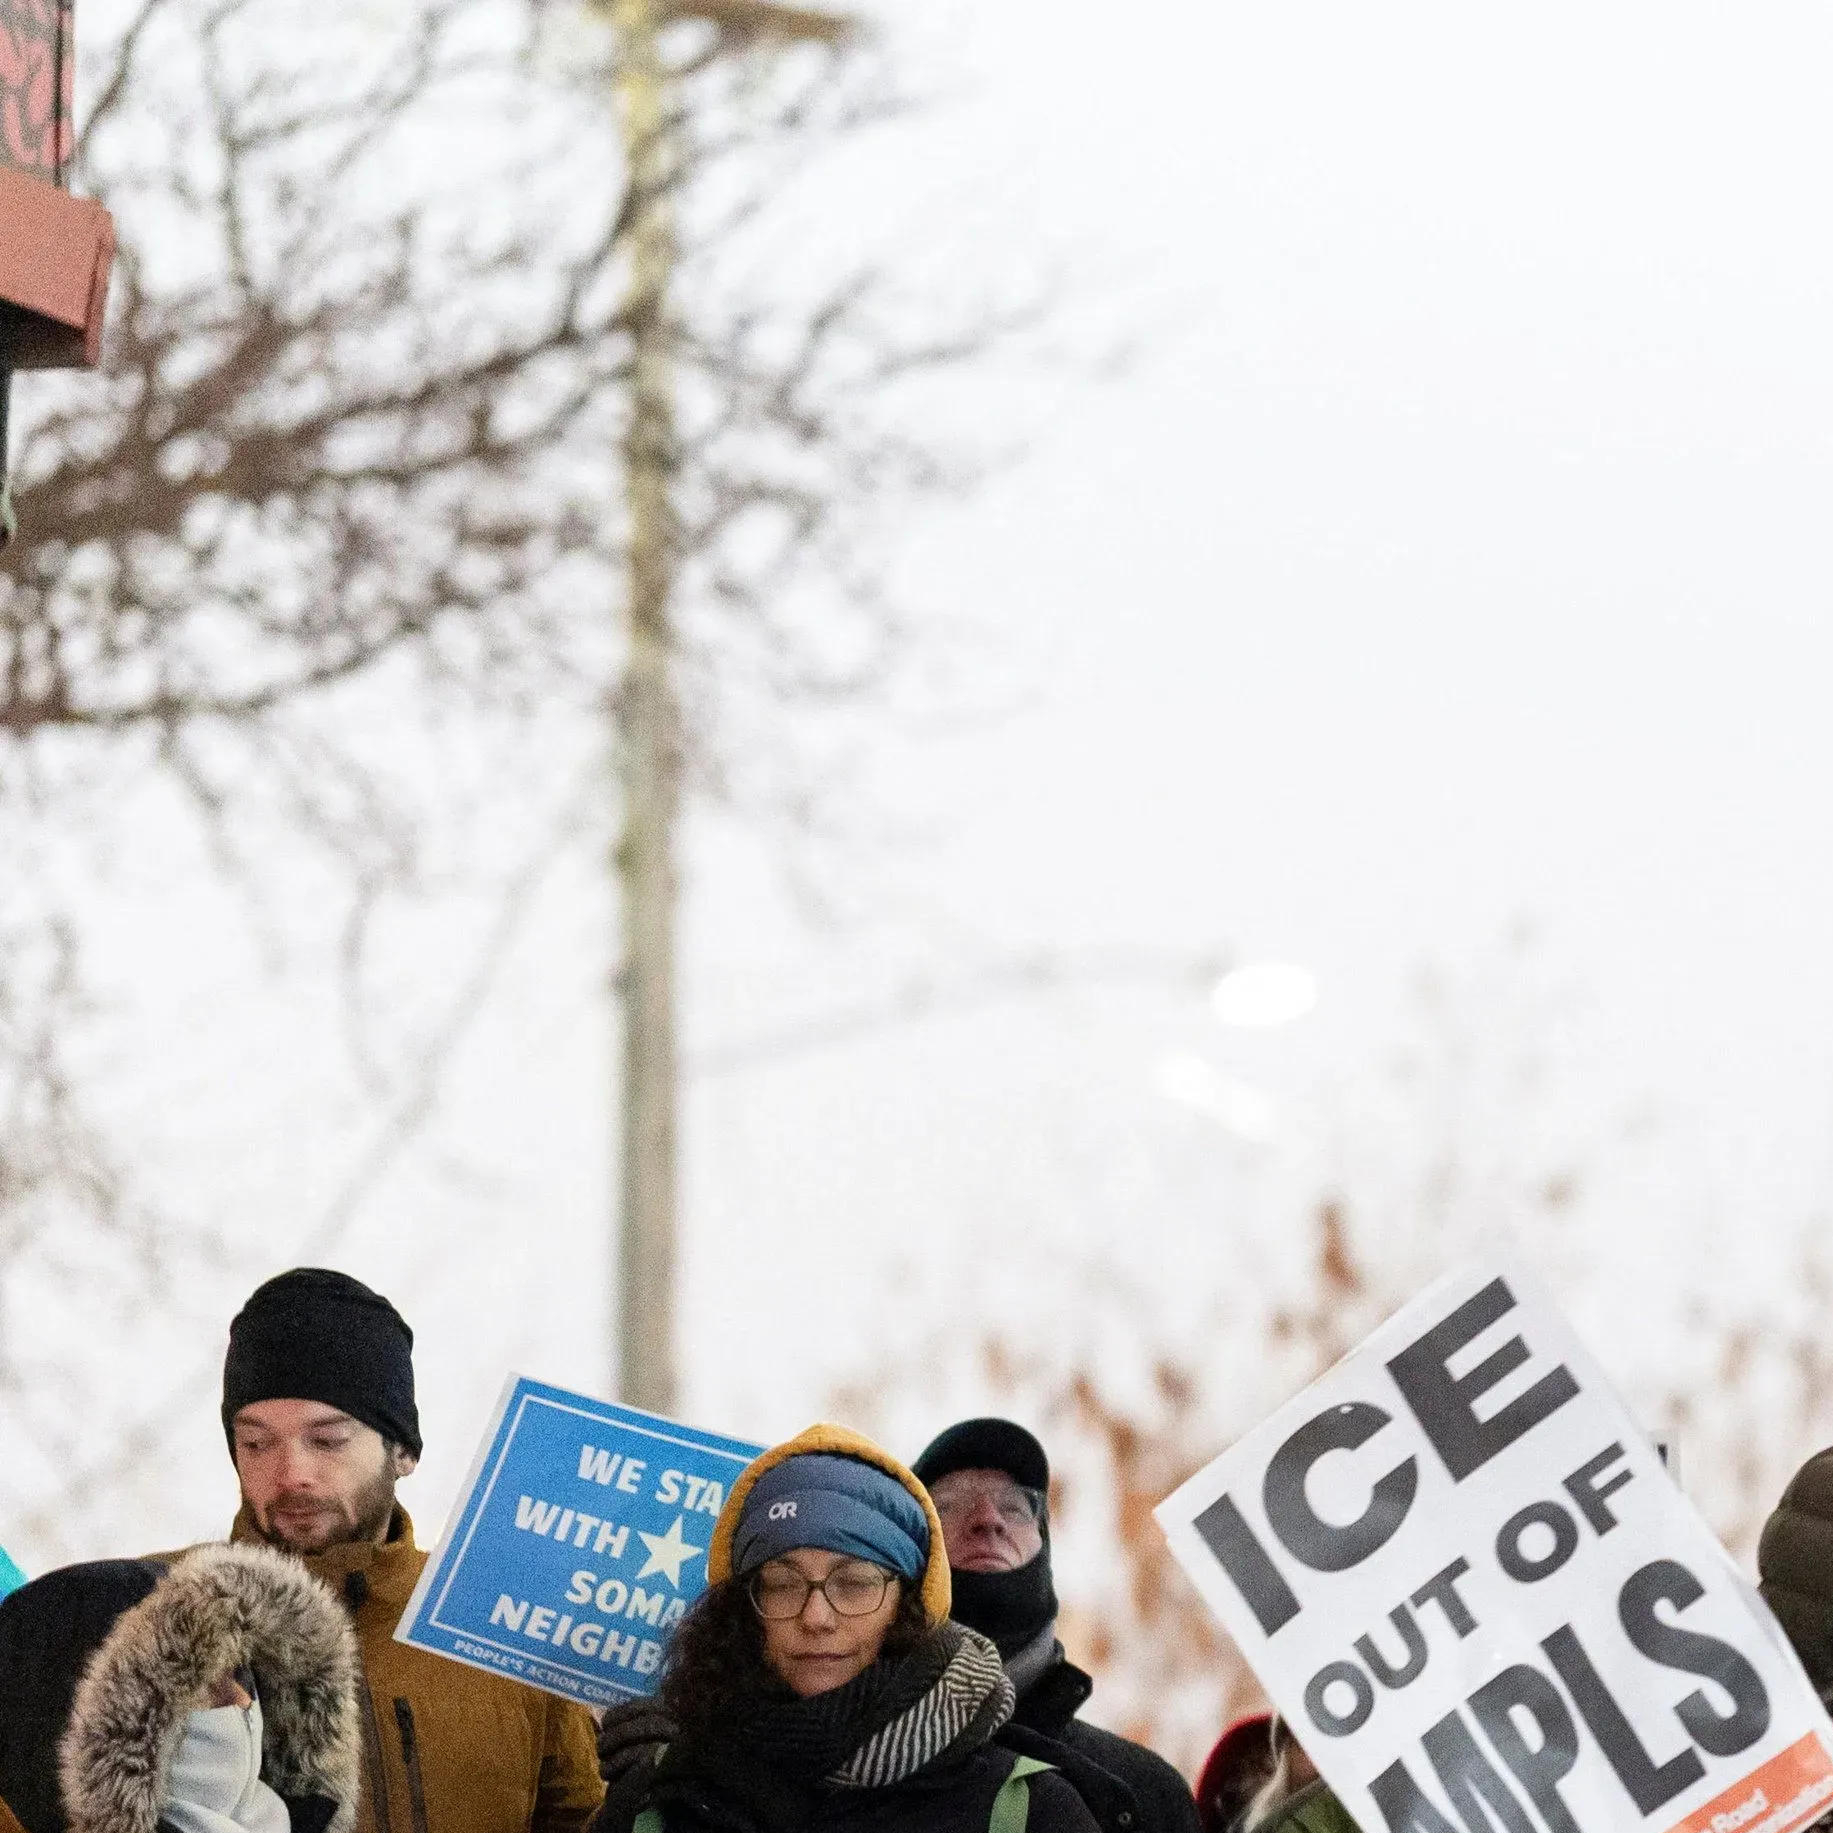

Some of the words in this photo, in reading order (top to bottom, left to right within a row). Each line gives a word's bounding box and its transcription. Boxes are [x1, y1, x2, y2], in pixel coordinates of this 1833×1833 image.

[578, 1443, 647, 1495] WE
[654, 1469, 725, 1517] STA
[1193, 1276, 1581, 1638] ICE
[514, 1494, 631, 1560] WITH
[769, 1501, 797, 1520] OR
[565, 1570, 687, 1628] SOMA
[1304, 1557, 1479, 1739] OUT
[1495, 1440, 1636, 1584] OF
[454, 1639, 526, 1672] PEOPLE'S
[489, 1594, 670, 1676] NEIGHB
